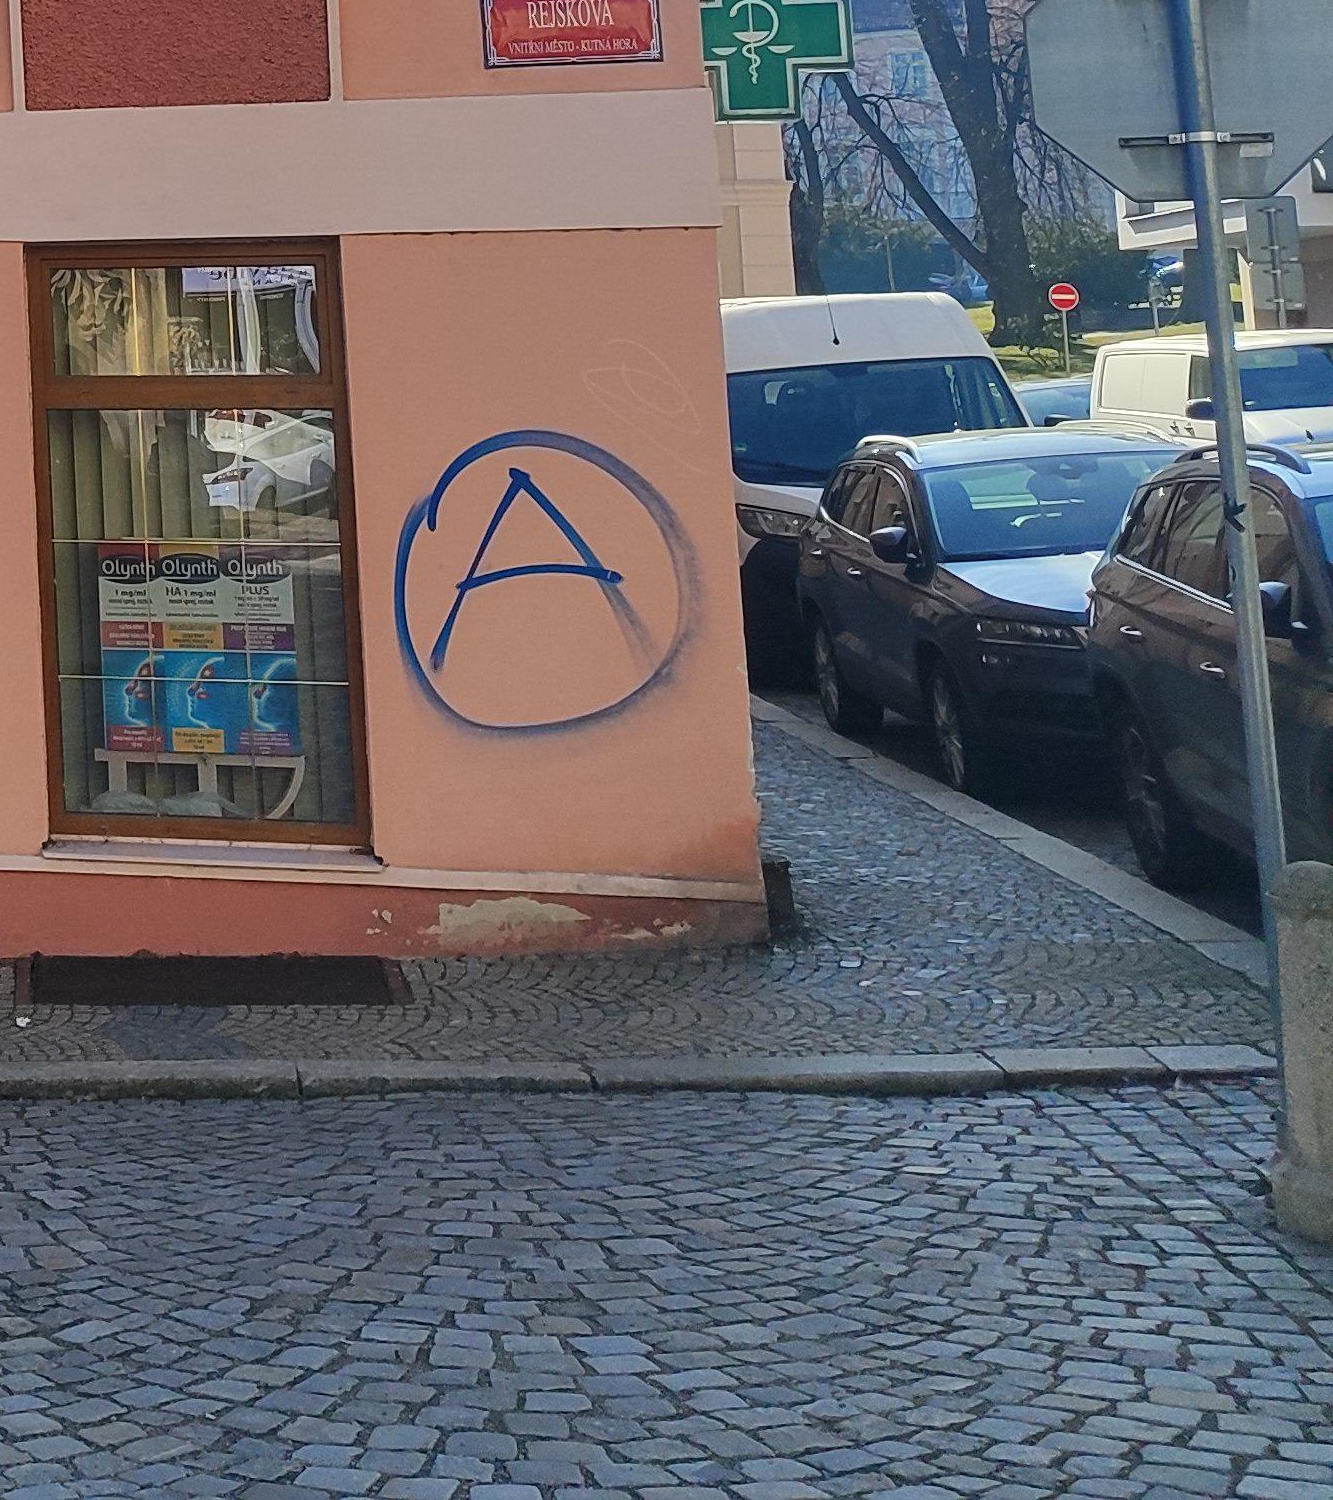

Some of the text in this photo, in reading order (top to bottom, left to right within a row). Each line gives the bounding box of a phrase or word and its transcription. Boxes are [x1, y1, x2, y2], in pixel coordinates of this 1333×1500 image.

[507, 40, 544, 55] VNITŘNÍ
[545, 38, 575, 53] MĚSTO
[581, 35, 612, 52] KUTNÁ
[613, 38, 639, 51] HORA
[101, 559, 156, 579] Olynth
[161, 558, 218, 579] Olynth
[227, 558, 284, 579] Olynth
[165, 586, 182, 597] HA
[242, 585, 270, 596] PLUS
